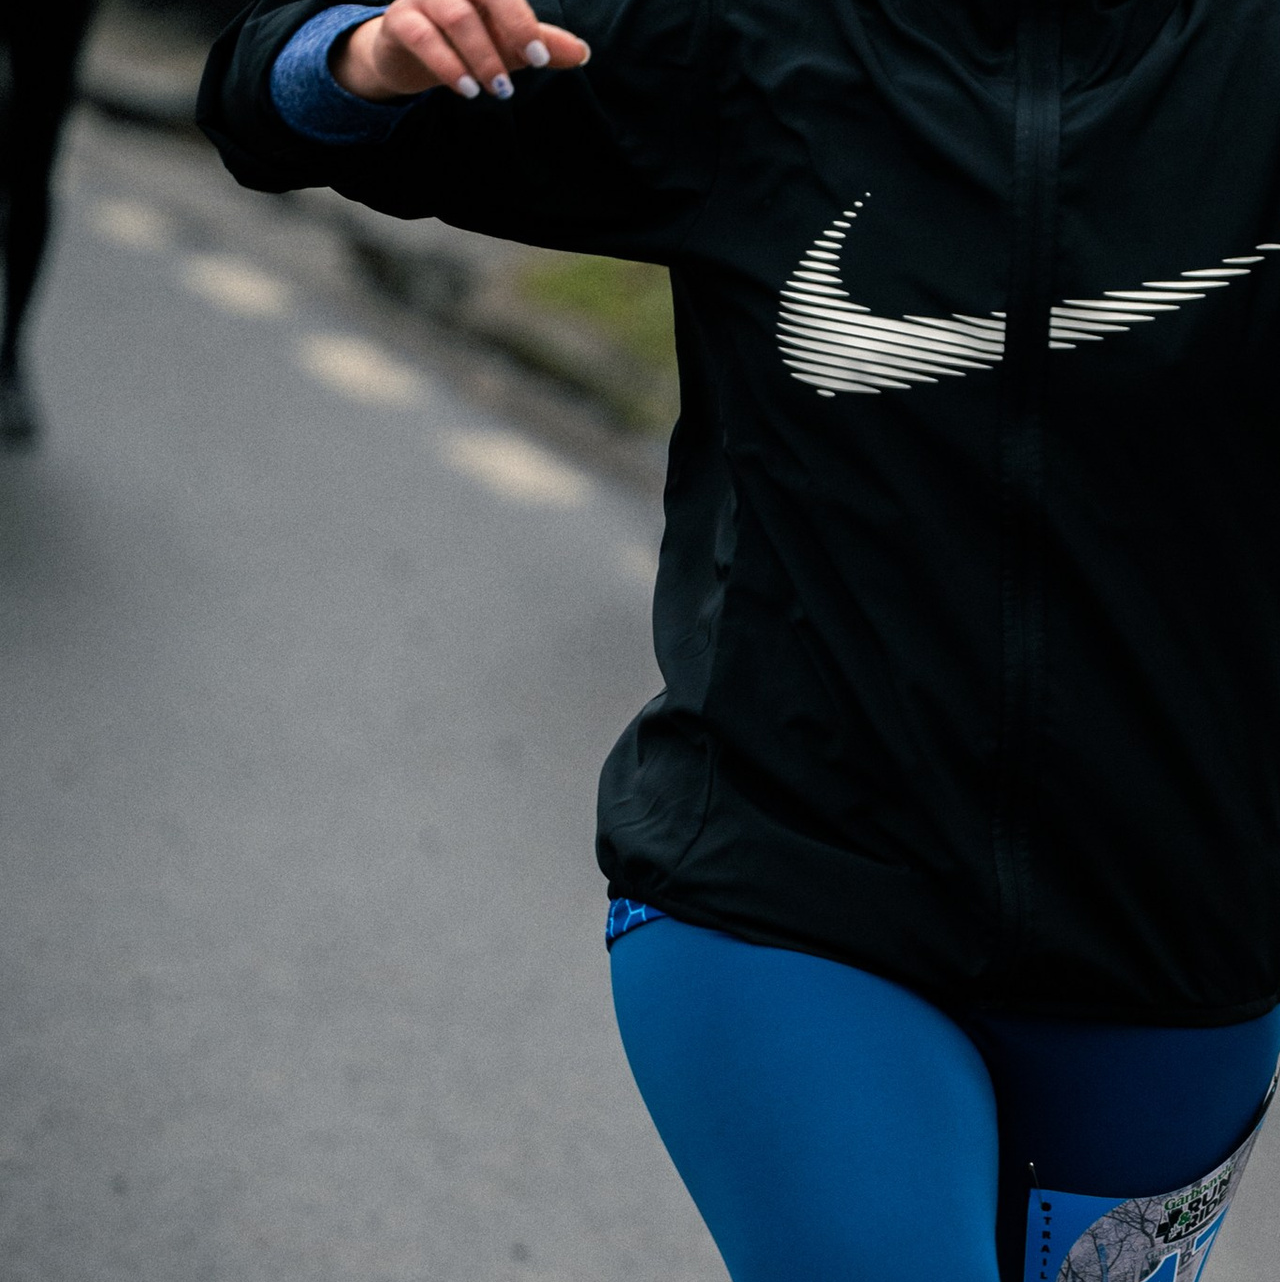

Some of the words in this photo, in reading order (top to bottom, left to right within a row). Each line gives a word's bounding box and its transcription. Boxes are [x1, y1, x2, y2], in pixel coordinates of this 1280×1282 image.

[1184, 1185, 1230, 1233] RIDE
[1187, 1172, 1232, 1213] RUN
[1040, 1216, 1052, 1280] TRAIL
